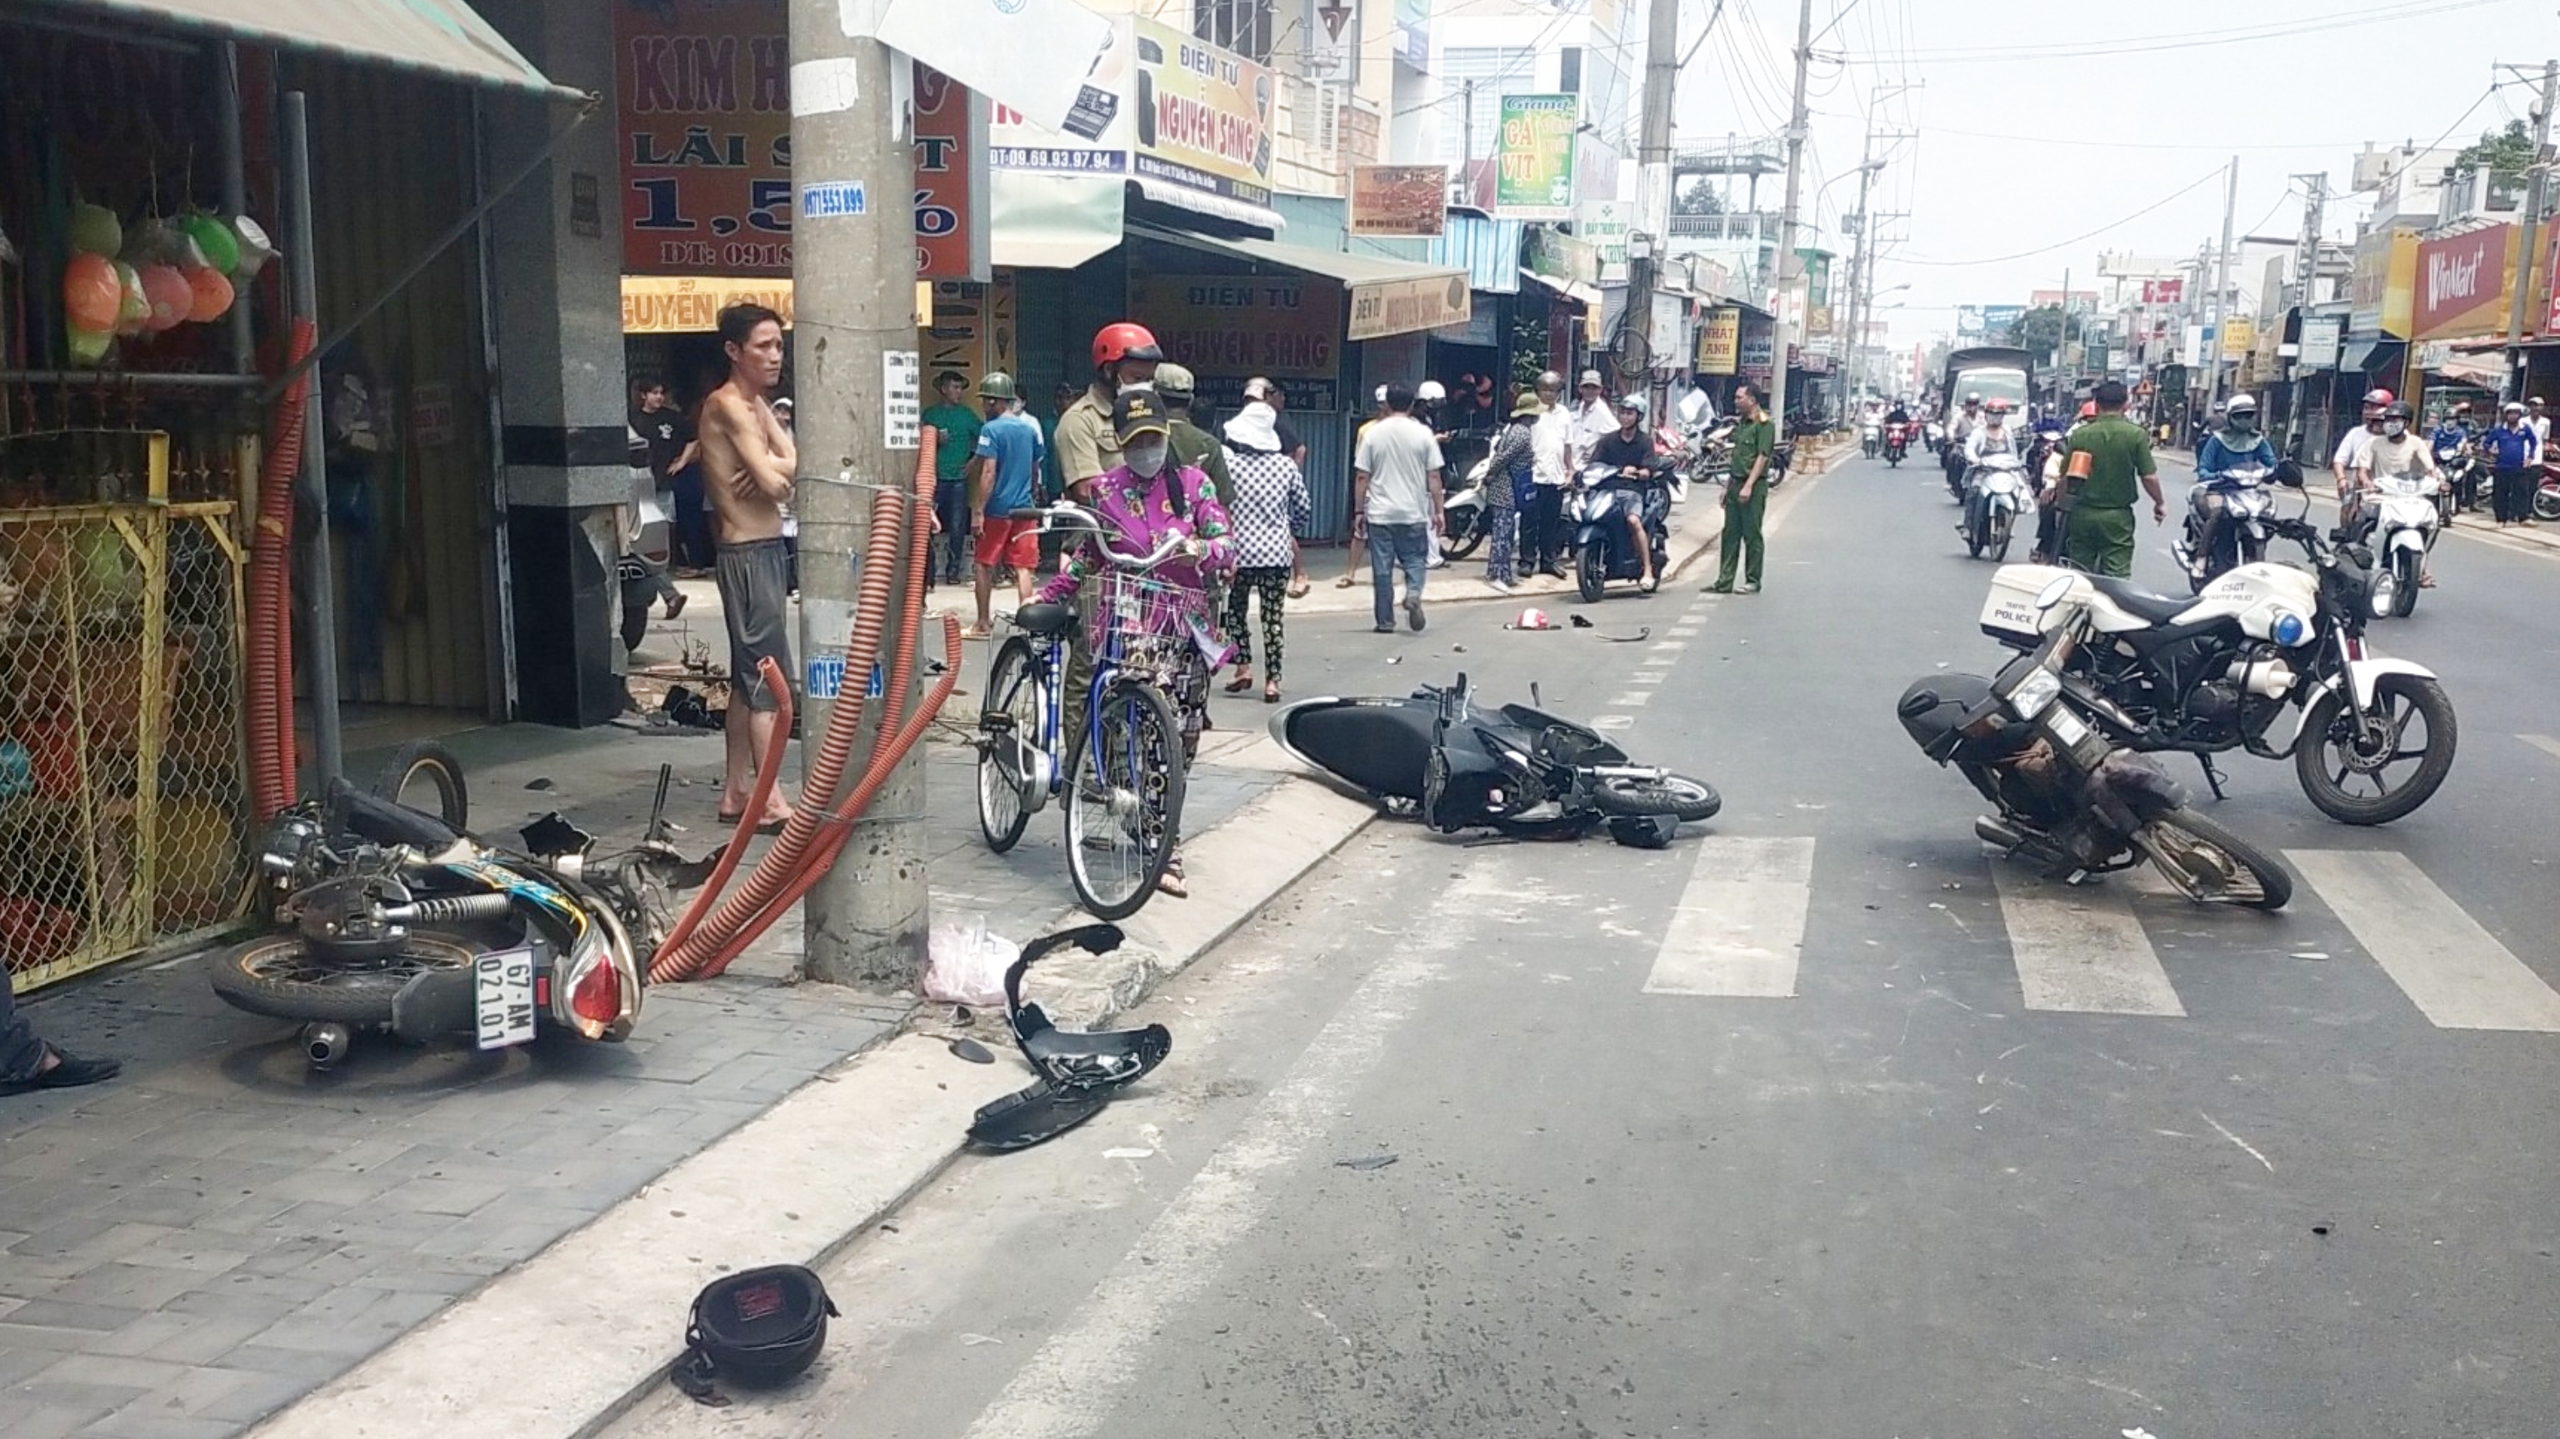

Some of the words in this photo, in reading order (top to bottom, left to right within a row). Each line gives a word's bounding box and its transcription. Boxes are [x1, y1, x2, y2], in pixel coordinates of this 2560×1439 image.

[631, 35, 739, 114] KIM
[631, 125, 749, 168] LÃI
[2221, 582, 2245, 592] CSGT
[1995, 609, 2033, 625] POLICE
[479, 959, 504, 1043] 021.01
